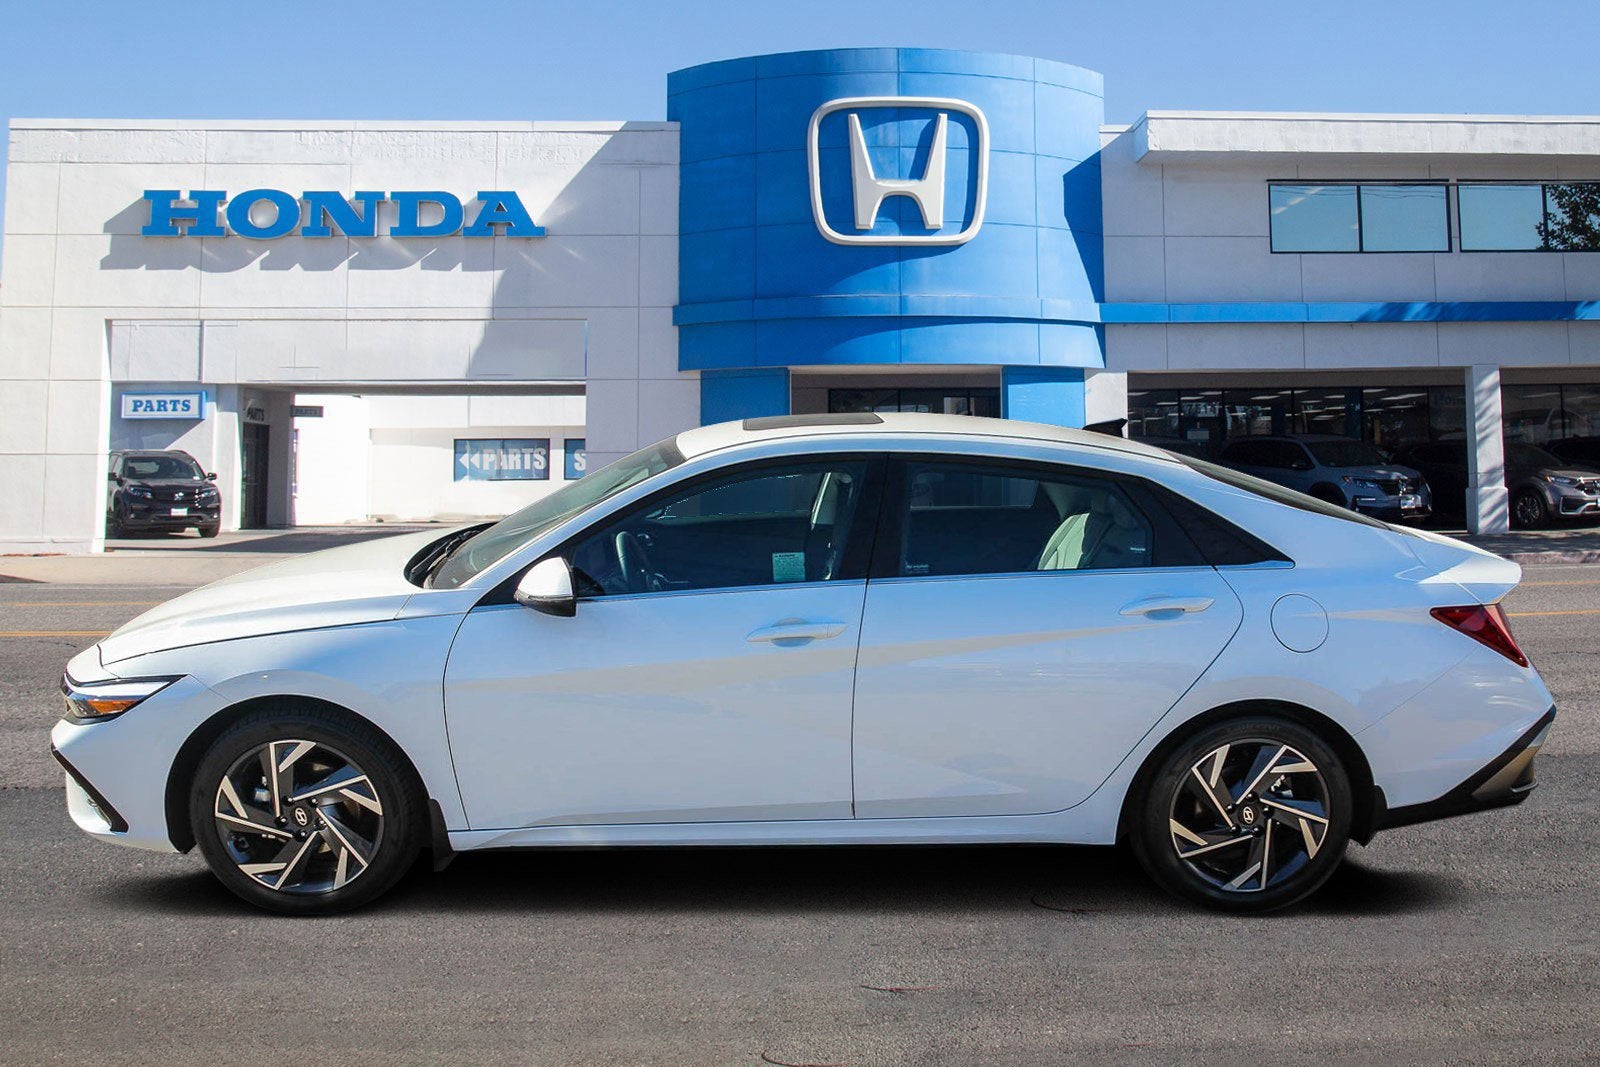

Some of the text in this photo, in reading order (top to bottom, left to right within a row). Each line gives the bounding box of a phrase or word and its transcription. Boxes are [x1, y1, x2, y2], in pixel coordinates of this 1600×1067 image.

[141, 188, 548, 240] HONDA
[132, 399, 191, 412] PARTS
[482, 448, 547, 470] PARTS
